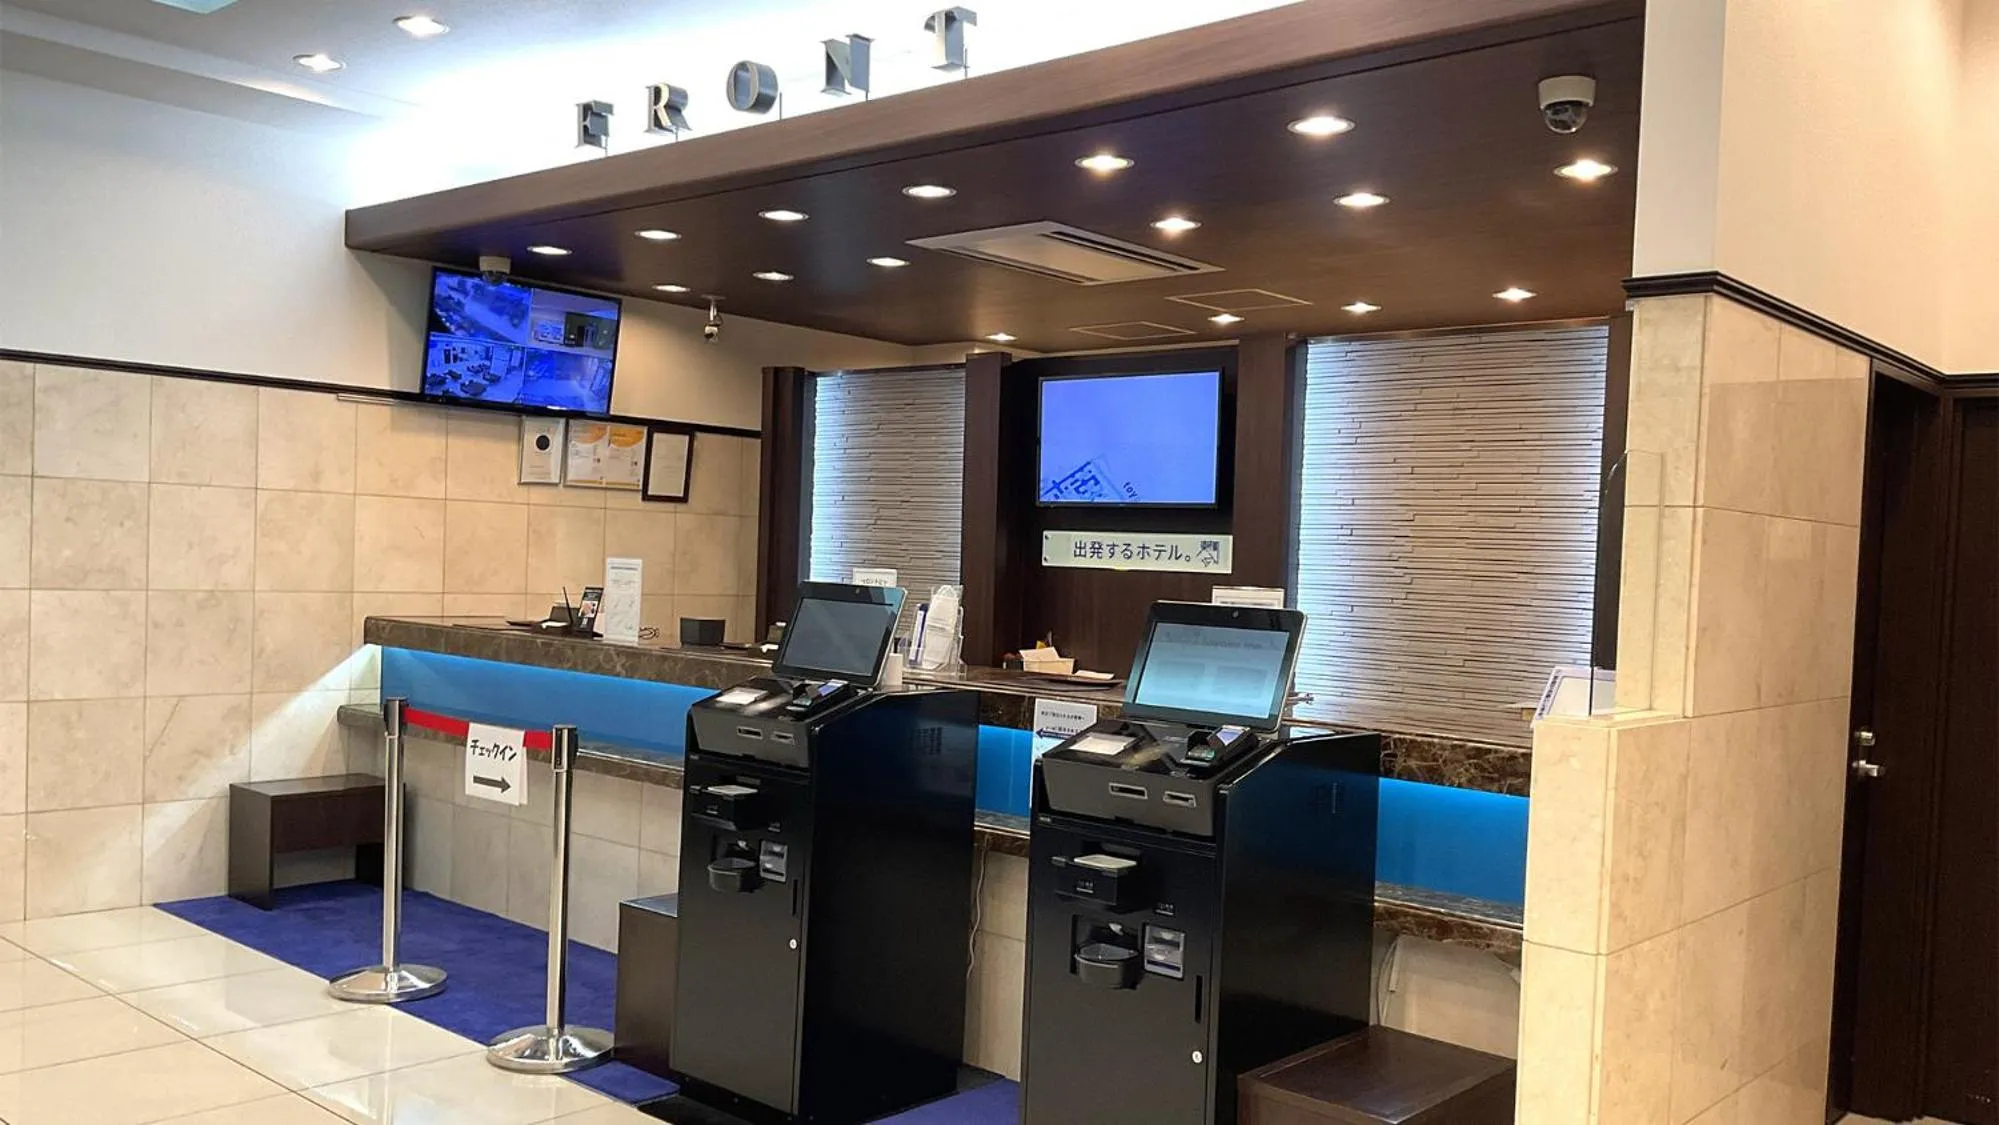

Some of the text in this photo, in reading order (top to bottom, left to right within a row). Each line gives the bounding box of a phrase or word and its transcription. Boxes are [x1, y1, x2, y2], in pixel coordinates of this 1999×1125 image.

[575, 6, 978, 149] FRONT
[1073, 539, 1191, 563] 出発するホテル。
[470, 739, 517, 761] チェックイン
